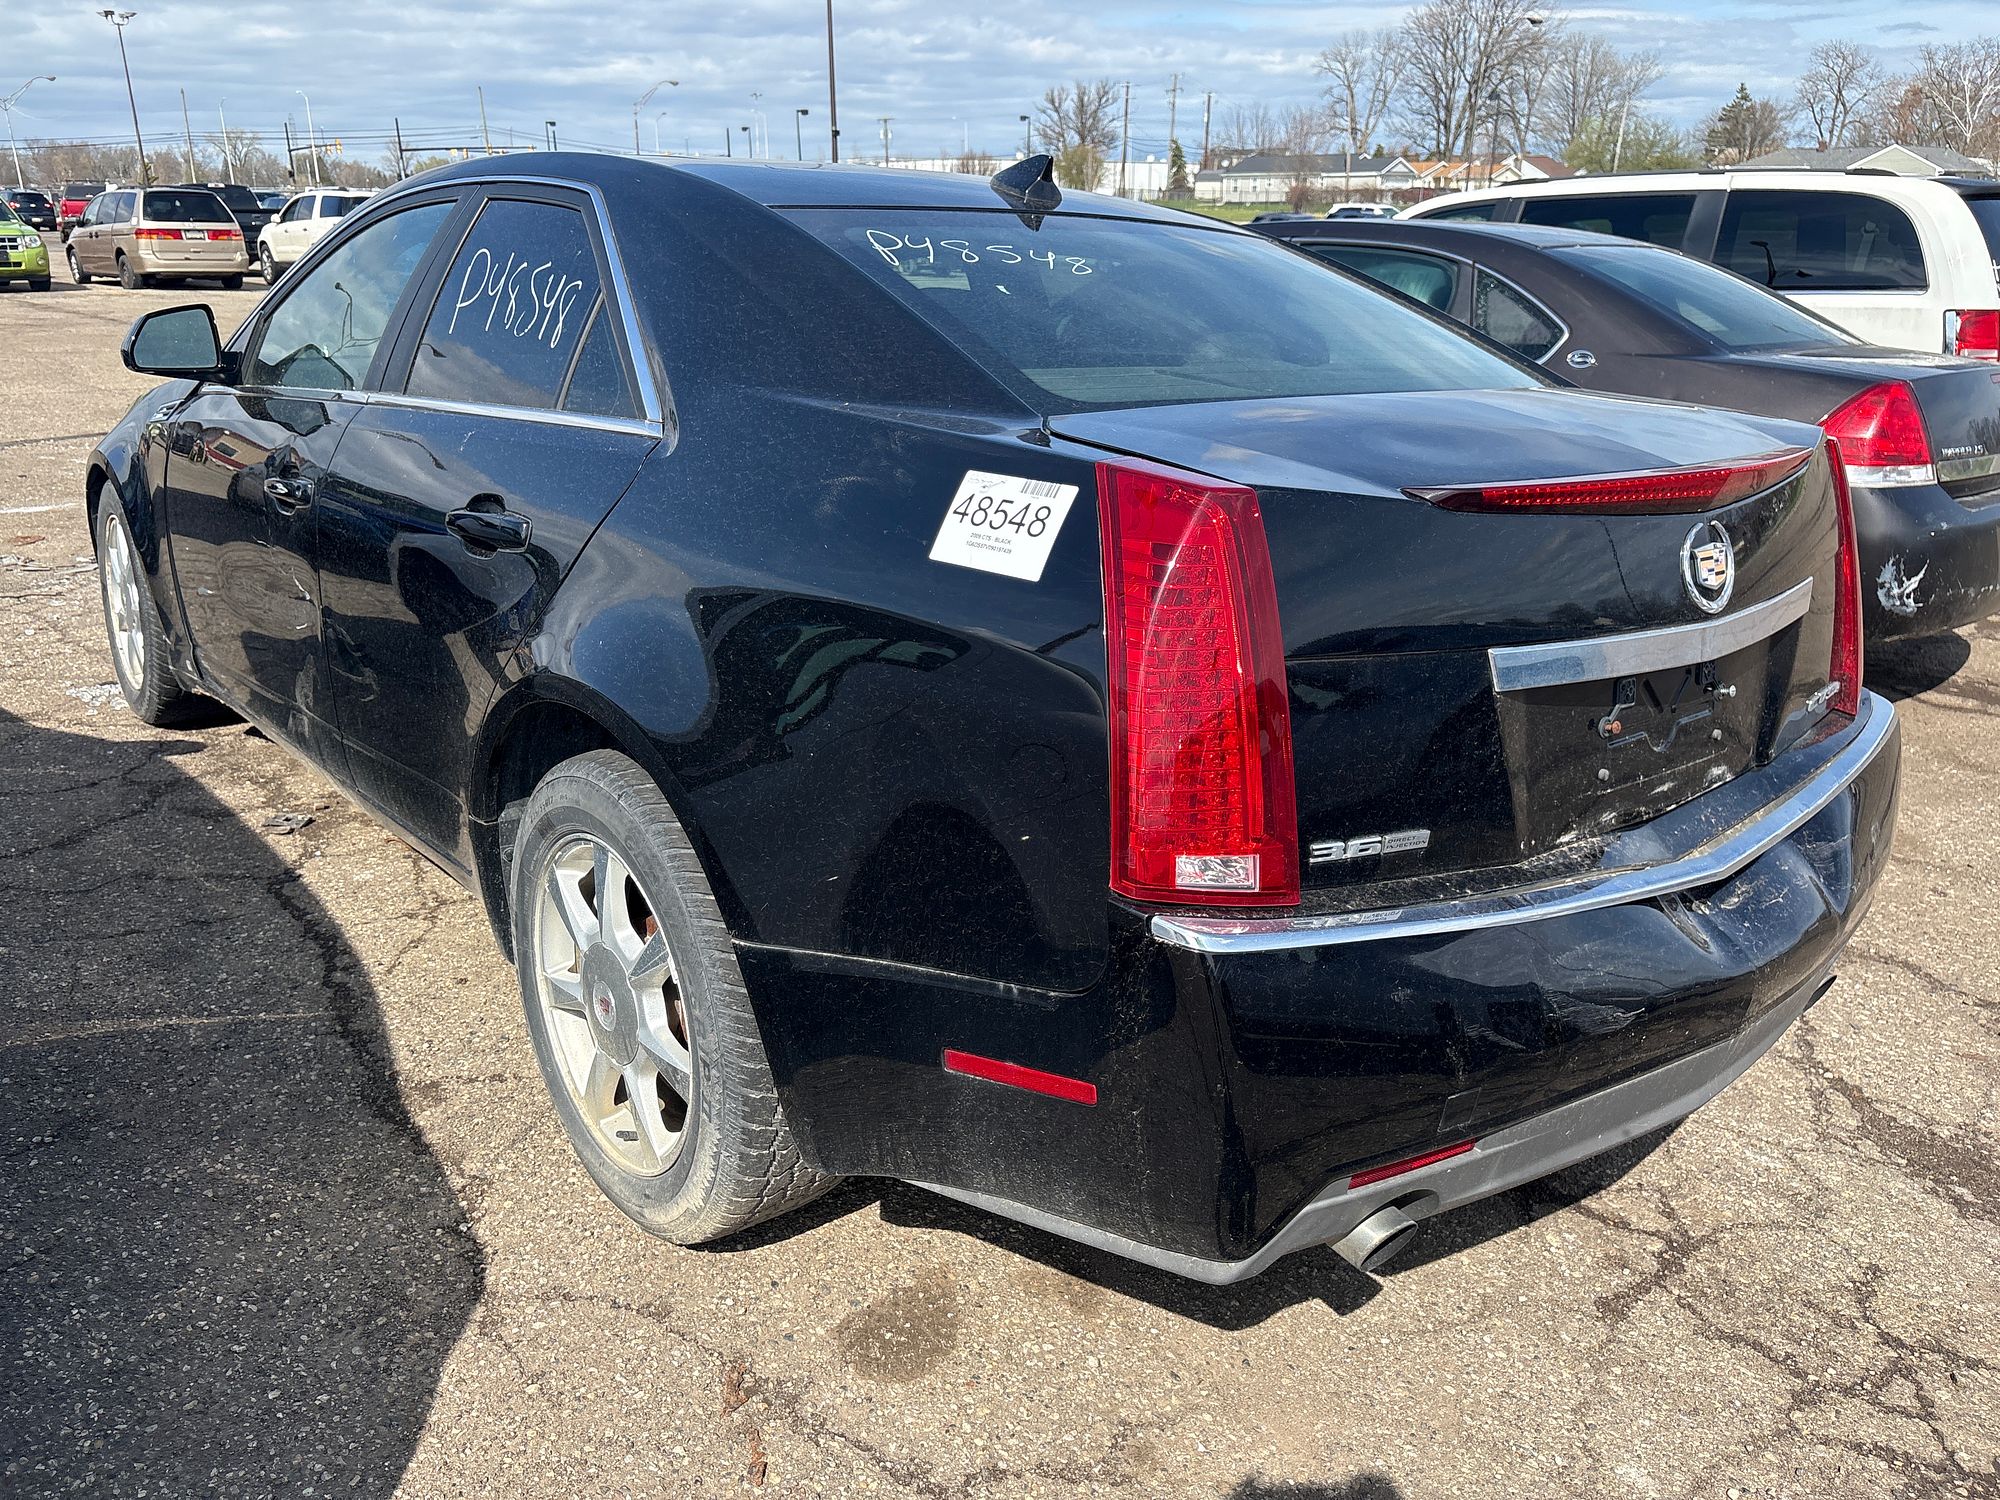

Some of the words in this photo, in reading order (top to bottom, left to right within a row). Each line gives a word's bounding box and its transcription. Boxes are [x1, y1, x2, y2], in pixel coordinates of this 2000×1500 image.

[866, 229, 1093, 275] P48548
[448, 248, 583, 349] P48548
[952, 493, 1052, 538] 48548
[1386, 839, 1427, 850] INJECTION
[1387, 836, 1417, 844] DIRECT
